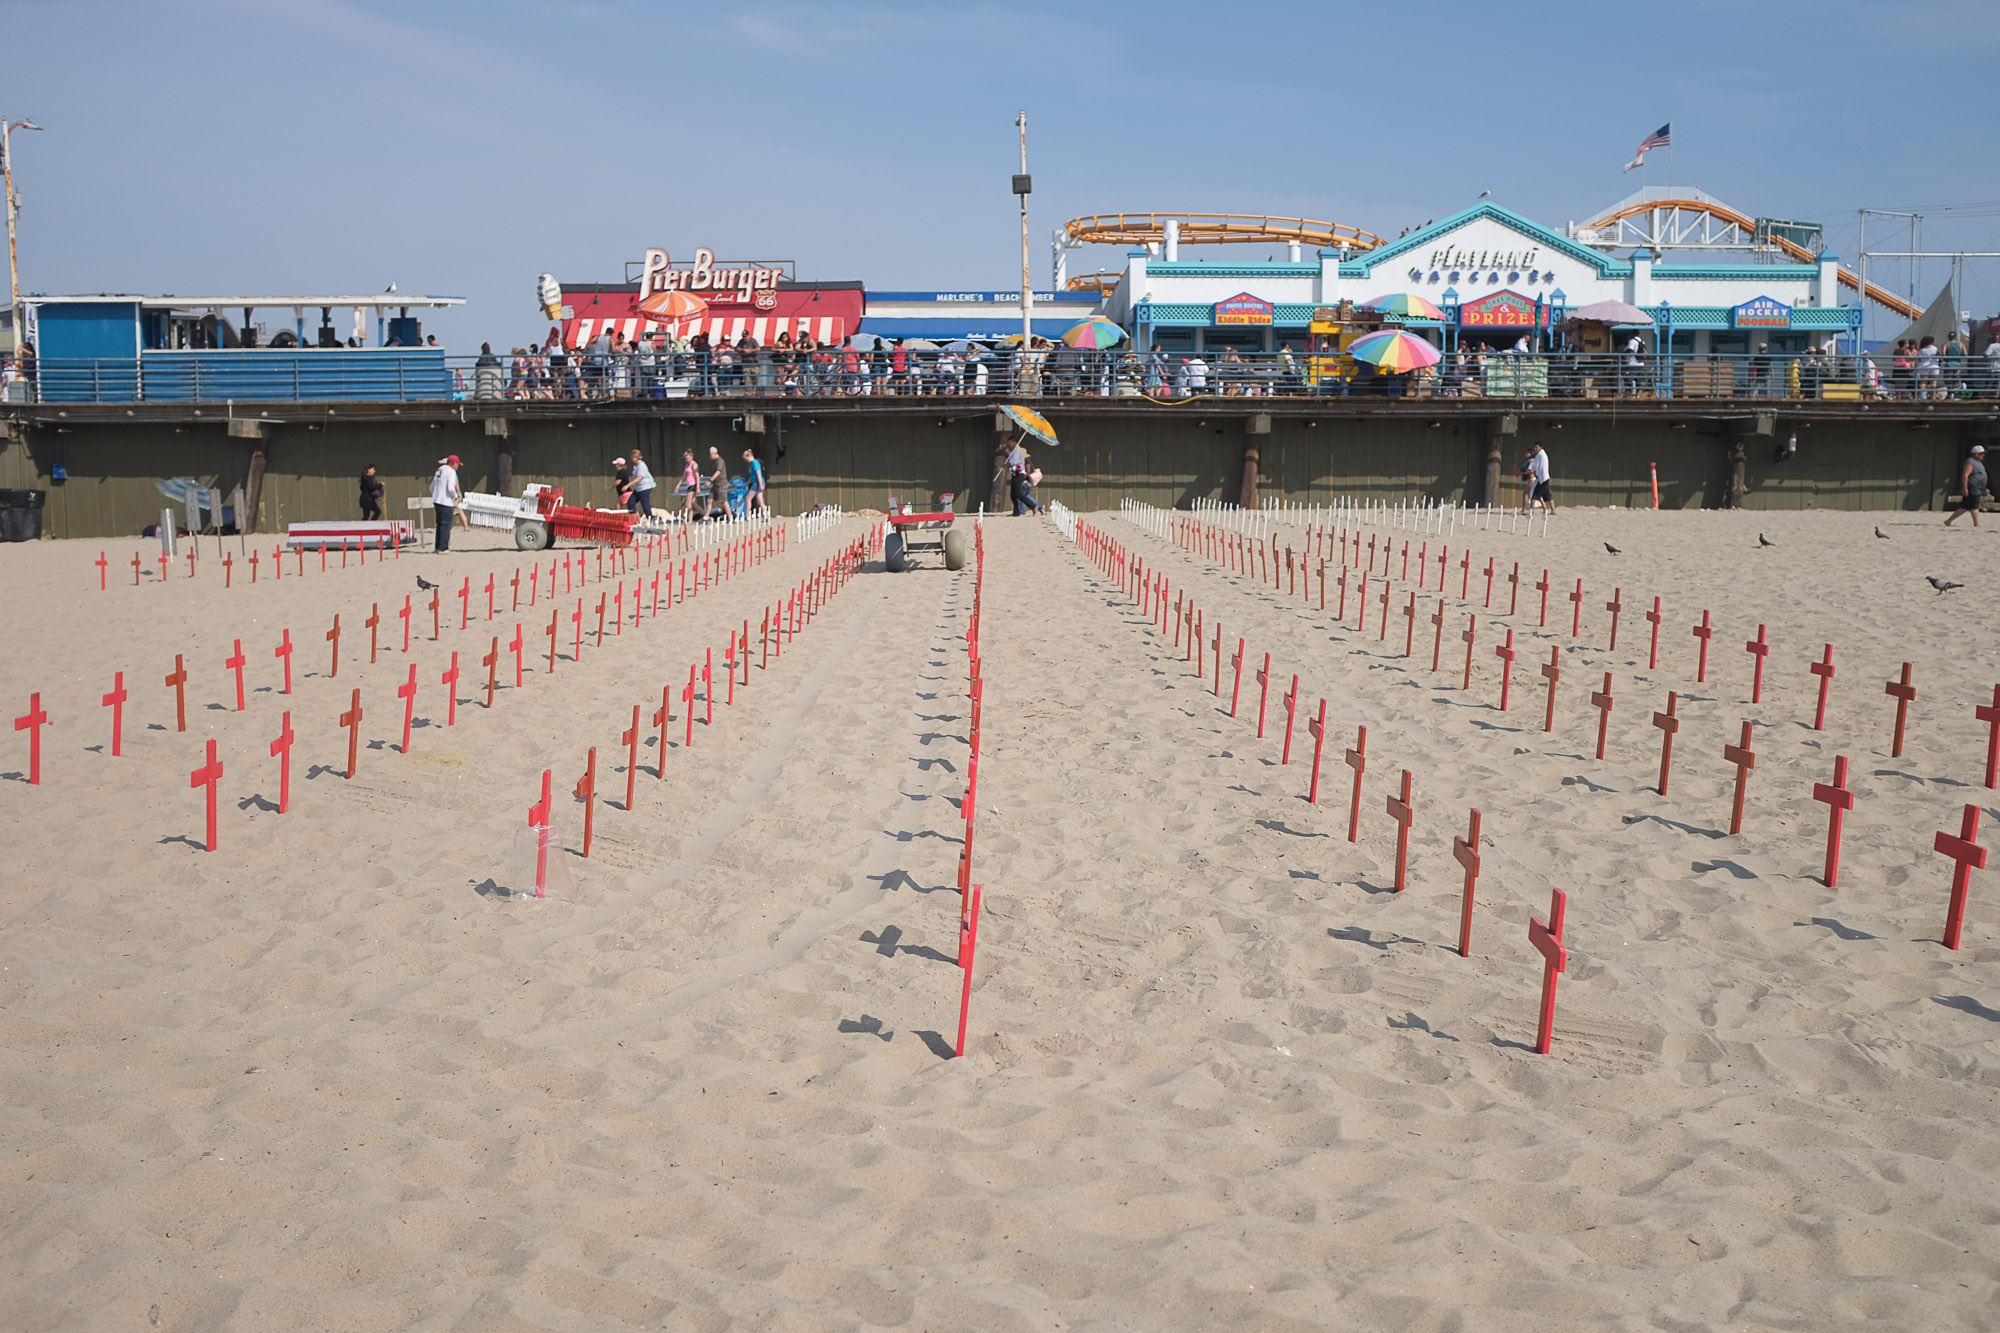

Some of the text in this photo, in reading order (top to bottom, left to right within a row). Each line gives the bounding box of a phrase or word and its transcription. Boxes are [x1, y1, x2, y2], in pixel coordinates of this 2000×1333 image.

[1431, 248, 1539, 269] PLAYLAND
[639, 247, 783, 303] PierBurger
[1430, 271, 1540, 283] ARCADE
[758, 296, 774, 306] 66
[936, 293, 1055, 302] MARLENE'S BEACHMBER
[1500, 303, 1510, 312] &
[1754, 301, 1773, 309] AIR
[1738, 308, 1788, 316] HOCKEY
[1217, 316, 1271, 324] Kiddie Rides
[1737, 317, 1788, 327] FOOSBALL
